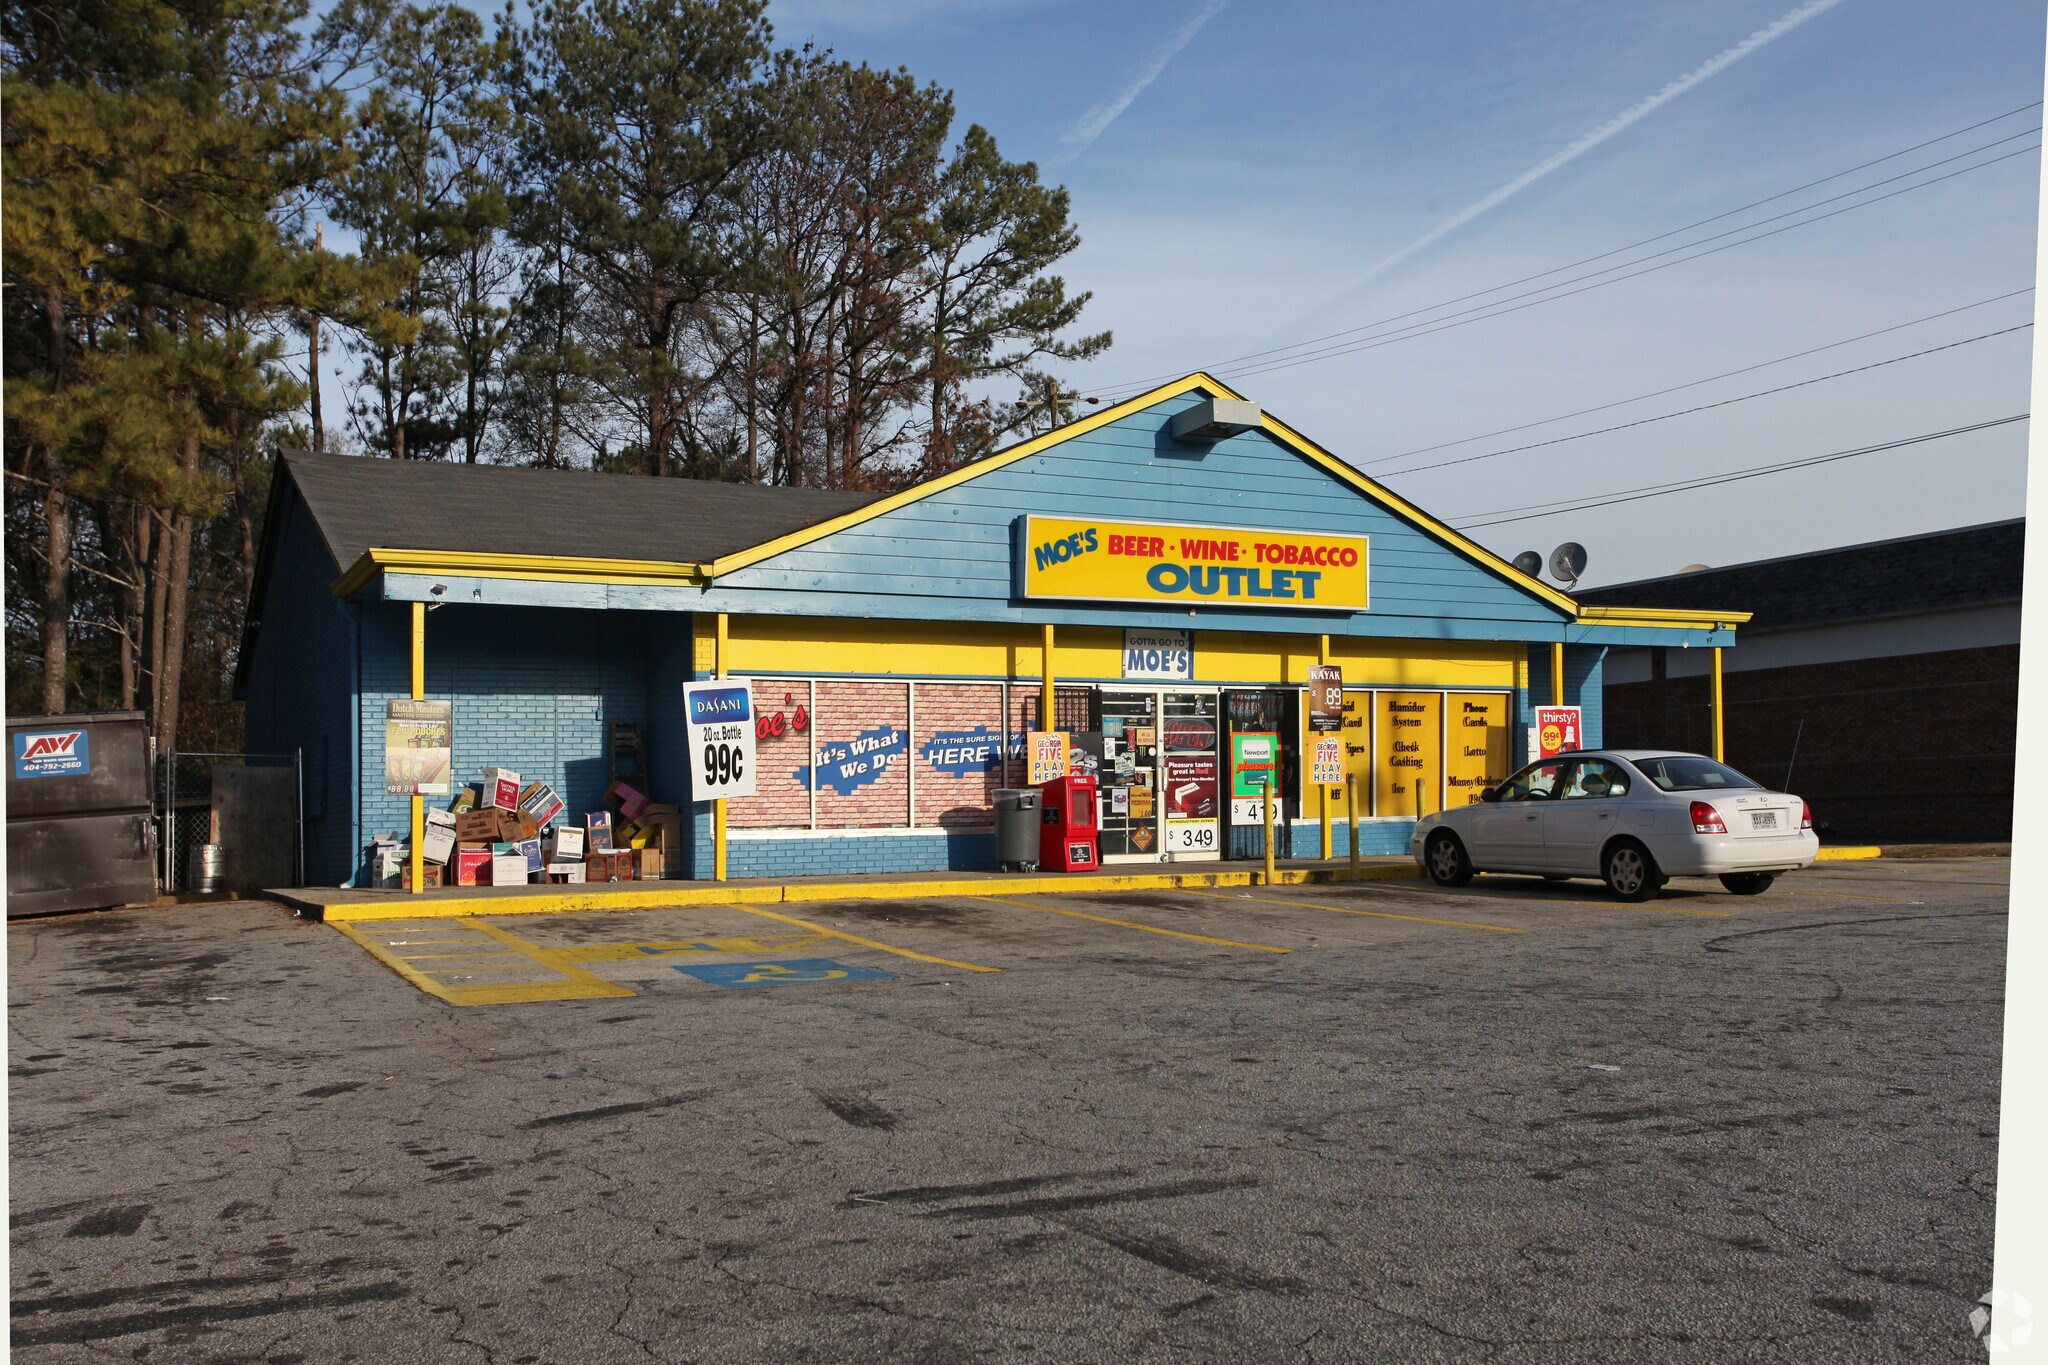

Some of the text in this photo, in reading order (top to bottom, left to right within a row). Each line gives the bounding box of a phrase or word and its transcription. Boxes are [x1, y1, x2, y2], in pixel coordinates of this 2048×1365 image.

[1034, 528, 1358, 572] MOE'S BEER WINE TOBACCO
[1147, 563, 1321, 599] OUTLET
[1130, 637, 1185, 647] GOTTA GO TO
[1128, 649, 1188, 673] MOE'S
[1310, 670, 1341, 680] KAYAK
[392, 702, 445, 713] Dutch Masters
[697, 697, 741, 714] DASANI
[1388, 700, 1426, 712] Humidor
[1463, 701, 1488, 713] Phone
[755, 693, 809, 740] oe's
[1391, 715, 1422, 730] System
[1462, 716, 1488, 728] Cards
[1542, 711, 1577, 725] thirsty?
[412, 727, 446, 736] POUCHES
[703, 725, 742, 742] 20 oz. Bottle
[988, 734, 1006, 742] SIG
[1167, 721, 1212, 749] OPEN
[1543, 732, 1559, 742] 99¢
[815, 730, 899, 767] It's What
[1393, 740, 1420, 752] Check
[1464, 745, 1487, 756] Lotto
[928, 746, 990, 765] HERE
[1038, 747, 1062, 761] FIVE
[1317, 751, 1338, 762] FIVE
[704, 744, 743, 786] 99¢
[840, 753, 897, 779] We Do
[1034, 762, 1065, 771] PLAY
[1236, 760, 1277, 773] pleasure!
[1314, 763, 1341, 772] PLAY
[1389, 755, 1423, 770] Cashing
[1313, 773, 1340, 782] HERE
[1448, 775, 1474, 790] Money
[1391, 782, 1406, 794] Ice
[1234, 804, 1239, 814] $
[1169, 829, 1213, 848] $ 3.49
